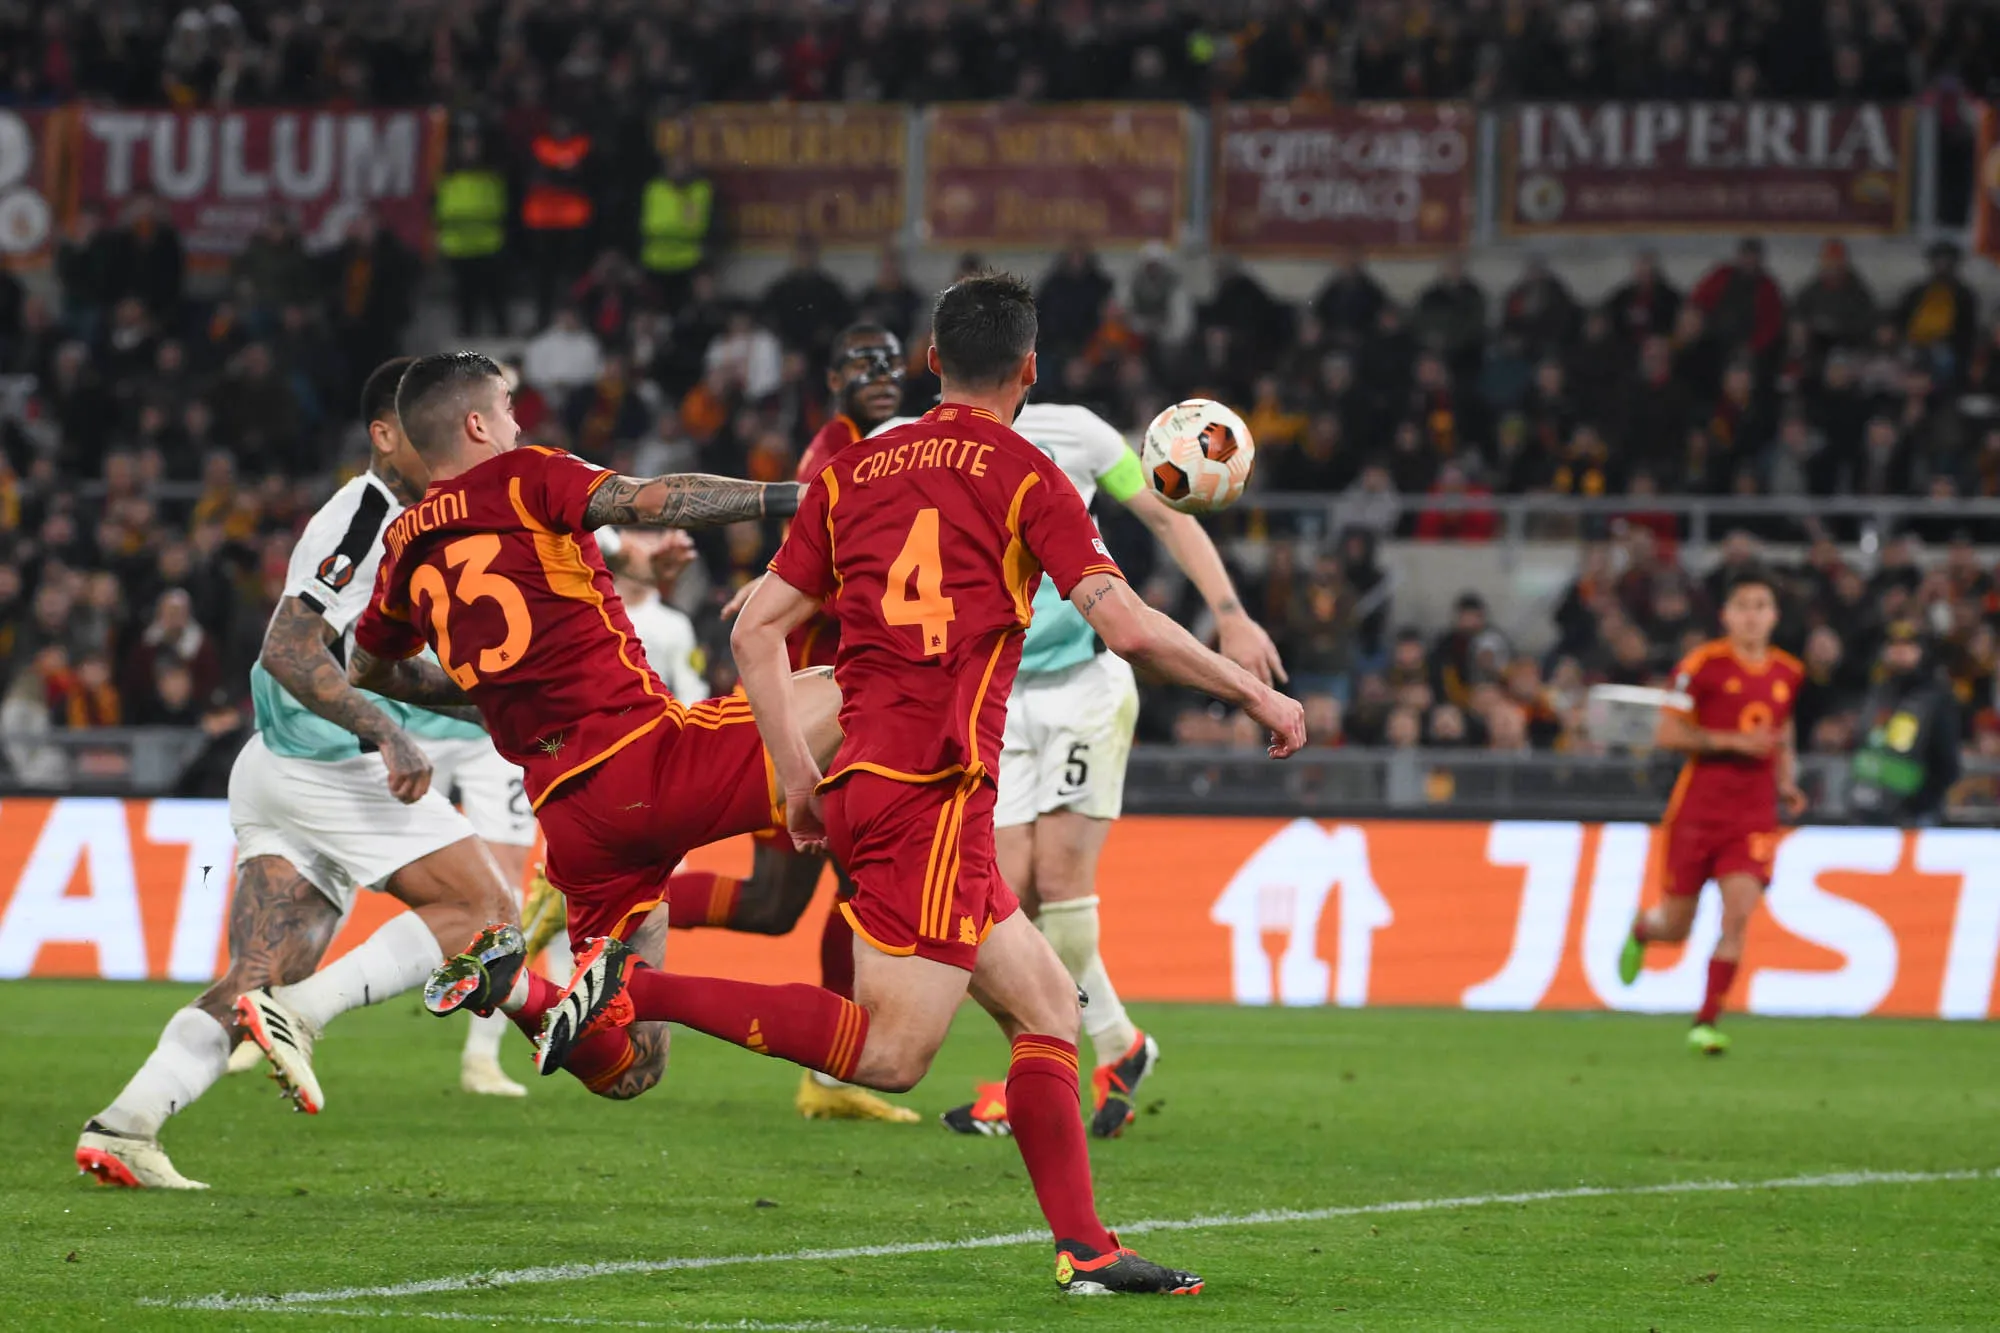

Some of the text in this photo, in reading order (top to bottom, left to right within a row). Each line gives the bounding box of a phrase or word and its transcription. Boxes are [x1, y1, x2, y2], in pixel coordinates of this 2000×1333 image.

[88, 112, 418, 198] TULUM
[1517, 103, 1897, 170] IMPERIA
[853, 438, 996, 484] CRISTANTE
[387, 489, 469, 562] MANCINI
[409, 533, 533, 691] 23
[881, 508, 956, 656] 4
[508, 778, 532, 816] 2
[1065, 741, 1089, 786] 5
[1461, 819, 2000, 1019] JUST
